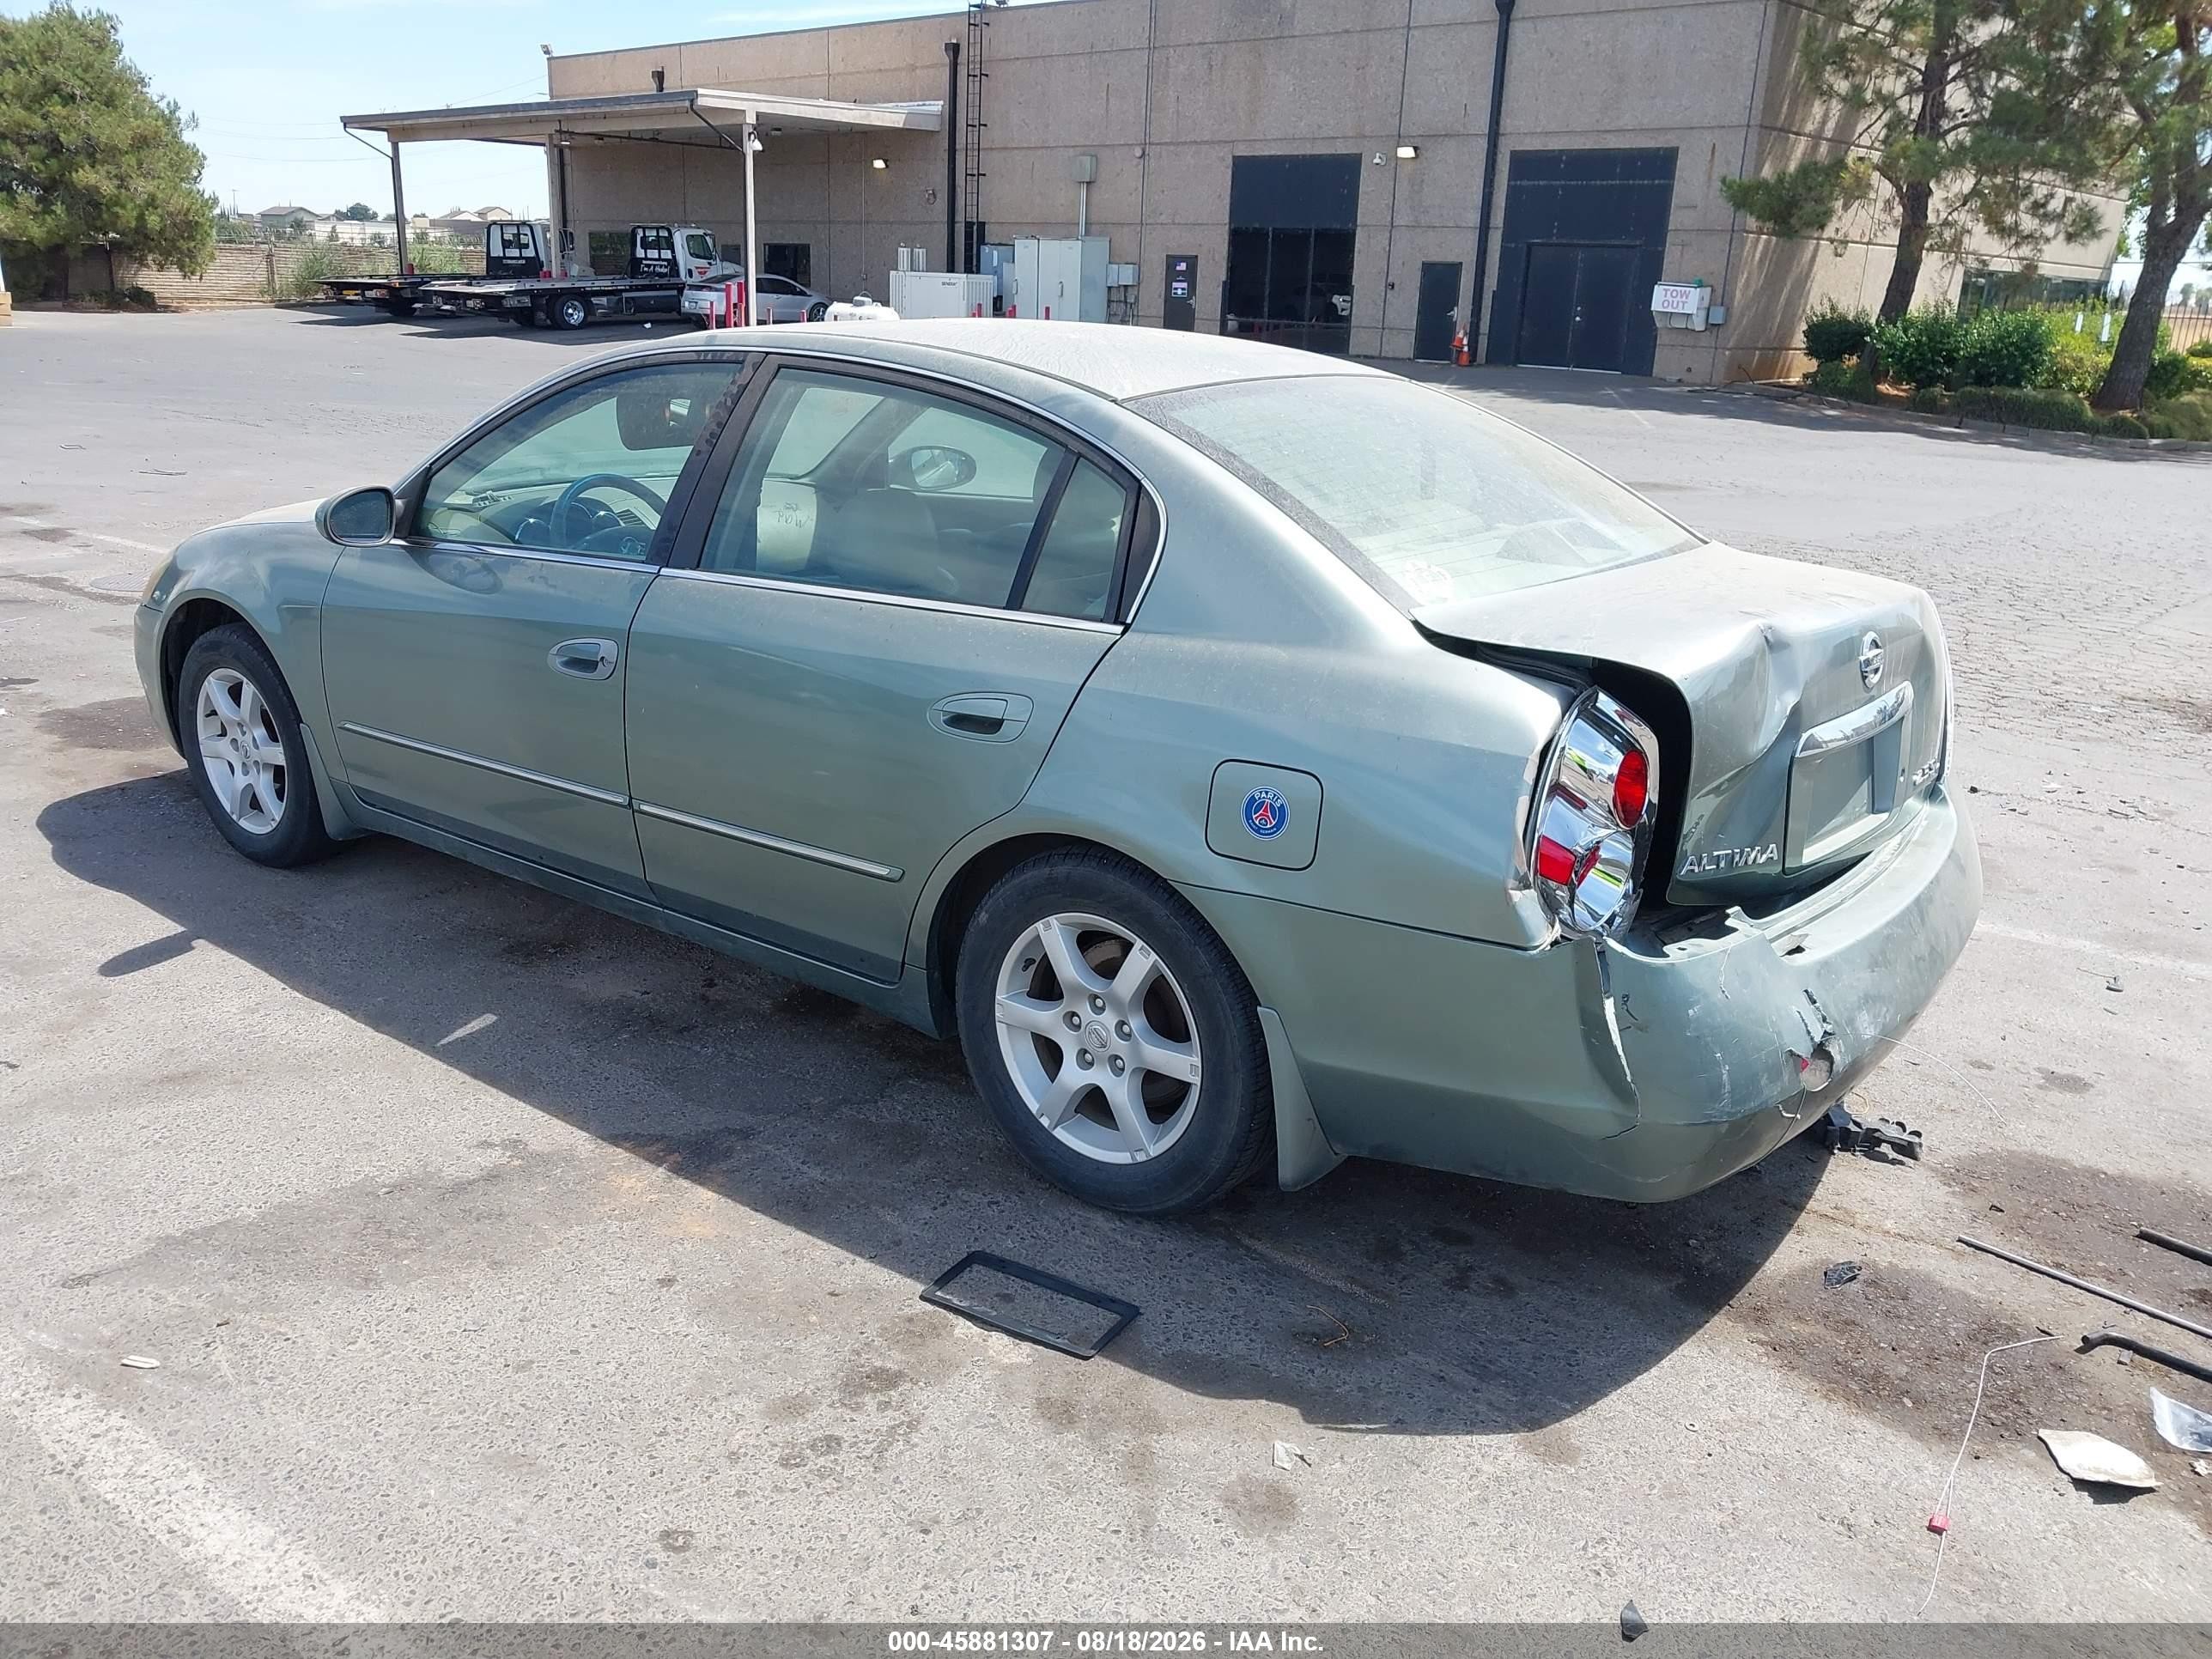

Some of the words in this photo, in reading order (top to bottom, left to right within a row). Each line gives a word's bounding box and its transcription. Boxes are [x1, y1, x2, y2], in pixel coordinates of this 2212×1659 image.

[1662, 288, 1691, 300] TOW
[1662, 299, 1688, 310] OUT
[1254, 791, 1283, 808] PARIS
[1680, 843, 1778, 876] ALTIMA
